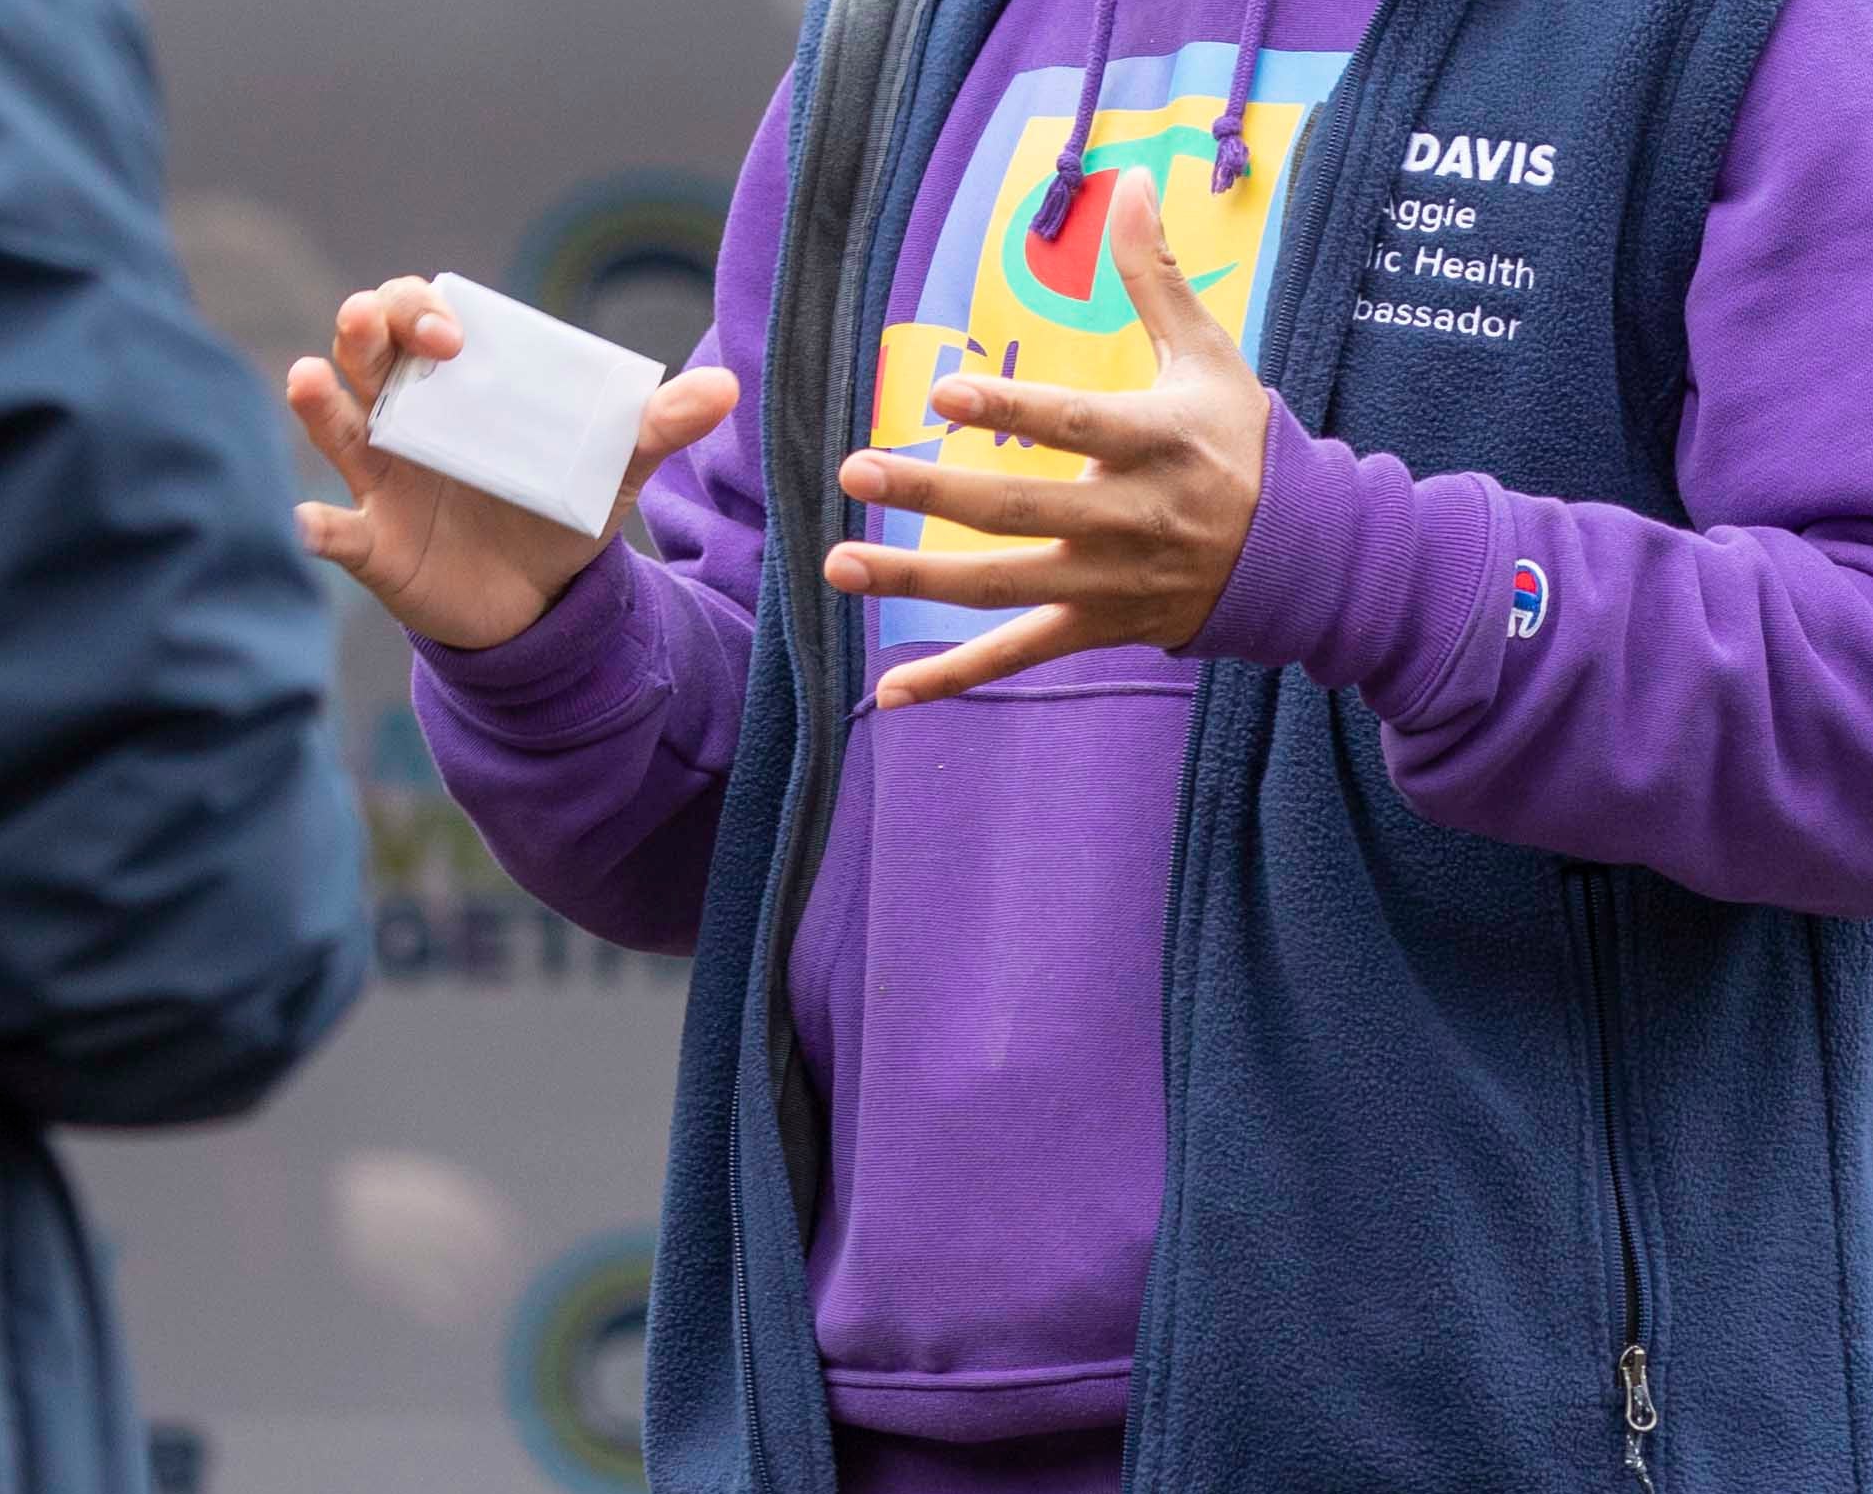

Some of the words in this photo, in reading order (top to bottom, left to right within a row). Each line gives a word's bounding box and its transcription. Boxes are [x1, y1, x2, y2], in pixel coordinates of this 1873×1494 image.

[1402, 132, 1557, 186] DAVIS
[1415, 246, 1535, 290] Health
[1353, 294, 1522, 340] bassador
